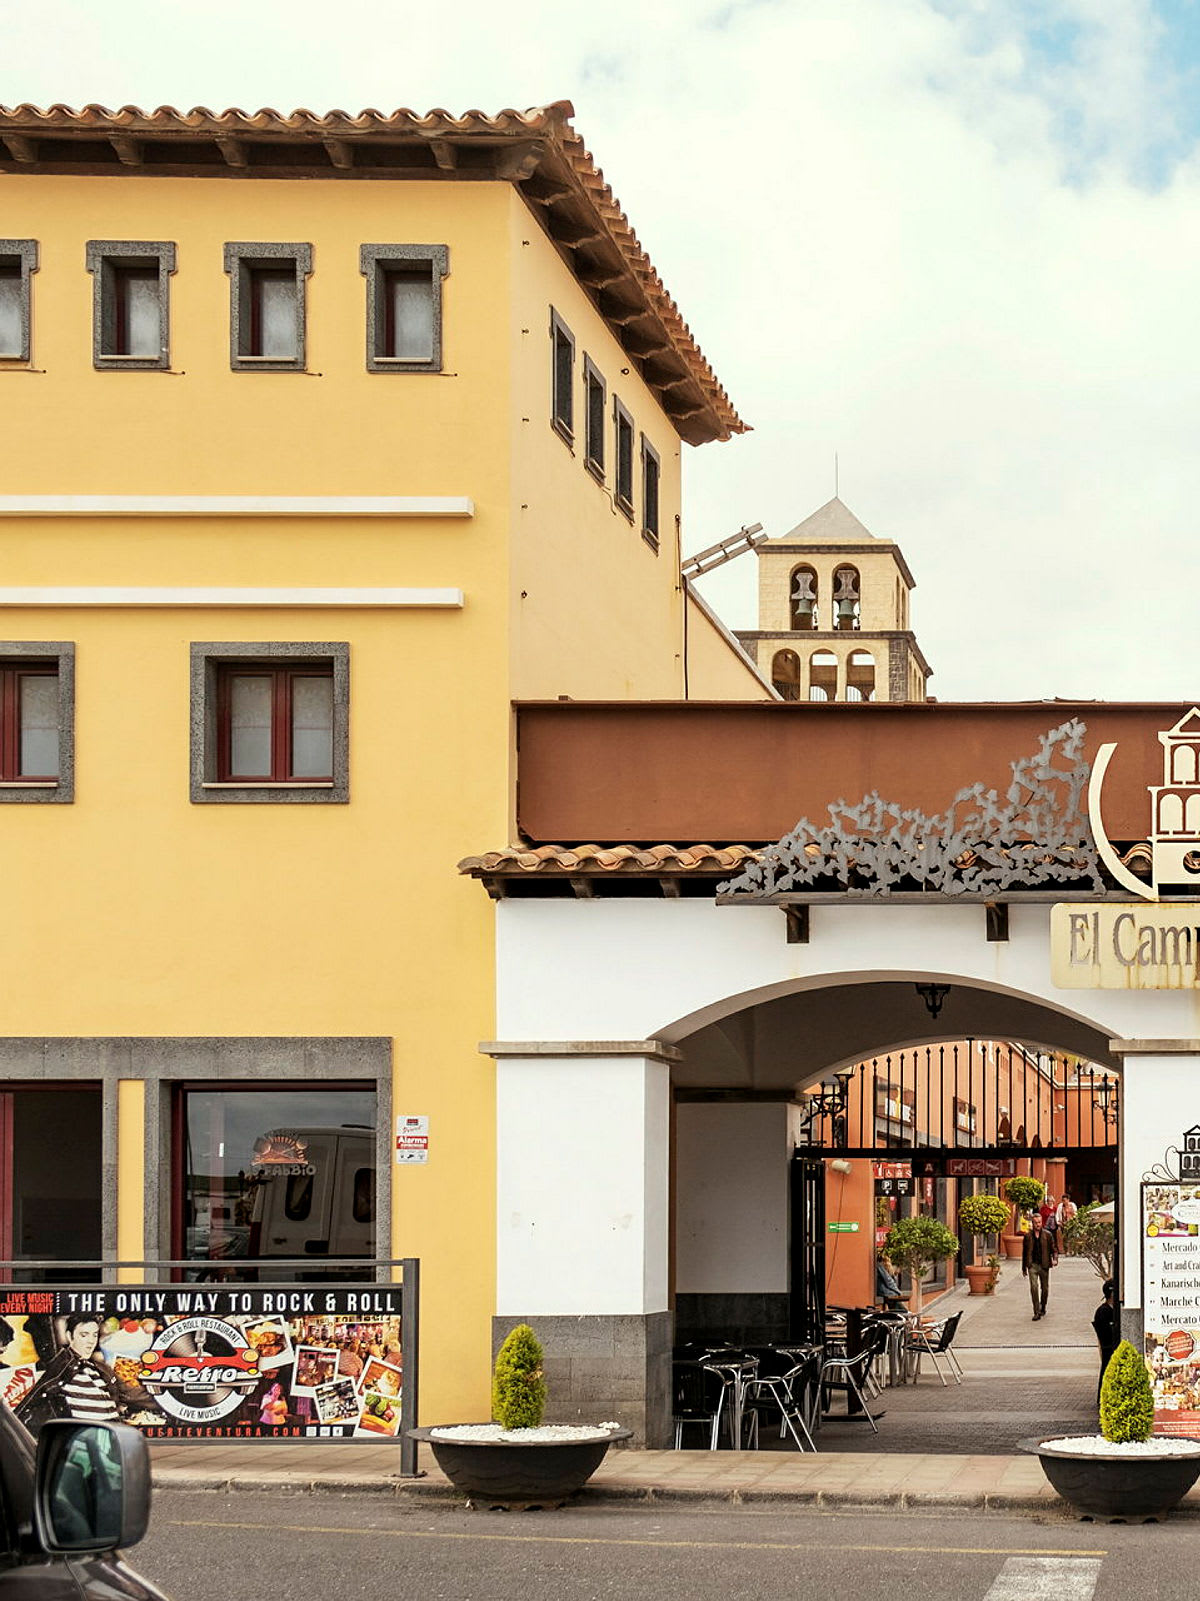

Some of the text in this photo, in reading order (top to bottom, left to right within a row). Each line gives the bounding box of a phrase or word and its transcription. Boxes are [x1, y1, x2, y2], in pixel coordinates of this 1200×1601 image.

[1069, 912, 1099, 966] El
[398, 1136, 427, 1144] Alarma
[924, 1158, 1015, 1174] A 1
[1162, 1241, 1198, 1252] Mercado
[1163, 1260, 1173, 1270] Art
[1174, 1260, 1187, 1270] and
[6, 1292, 54, 1303] LIVE MUSIC
[68, 1293, 396, 1312] THE ONLY WAY TO ROCK & ROLL
[1160, 1296, 1193, 1306] Marché
[0, 1302, 53, 1313] EVERY NIGHT
[1161, 1314, 1198, 1325] Mercato
[161, 1328, 178, 1345] ROCK
[183, 1319, 199, 1330] ROLL
[200, 1319, 241, 1343] RESTAURANT
[160, 1366, 238, 1382] Retro
[179, 1407, 221, 1419] LIVE MUSIC
